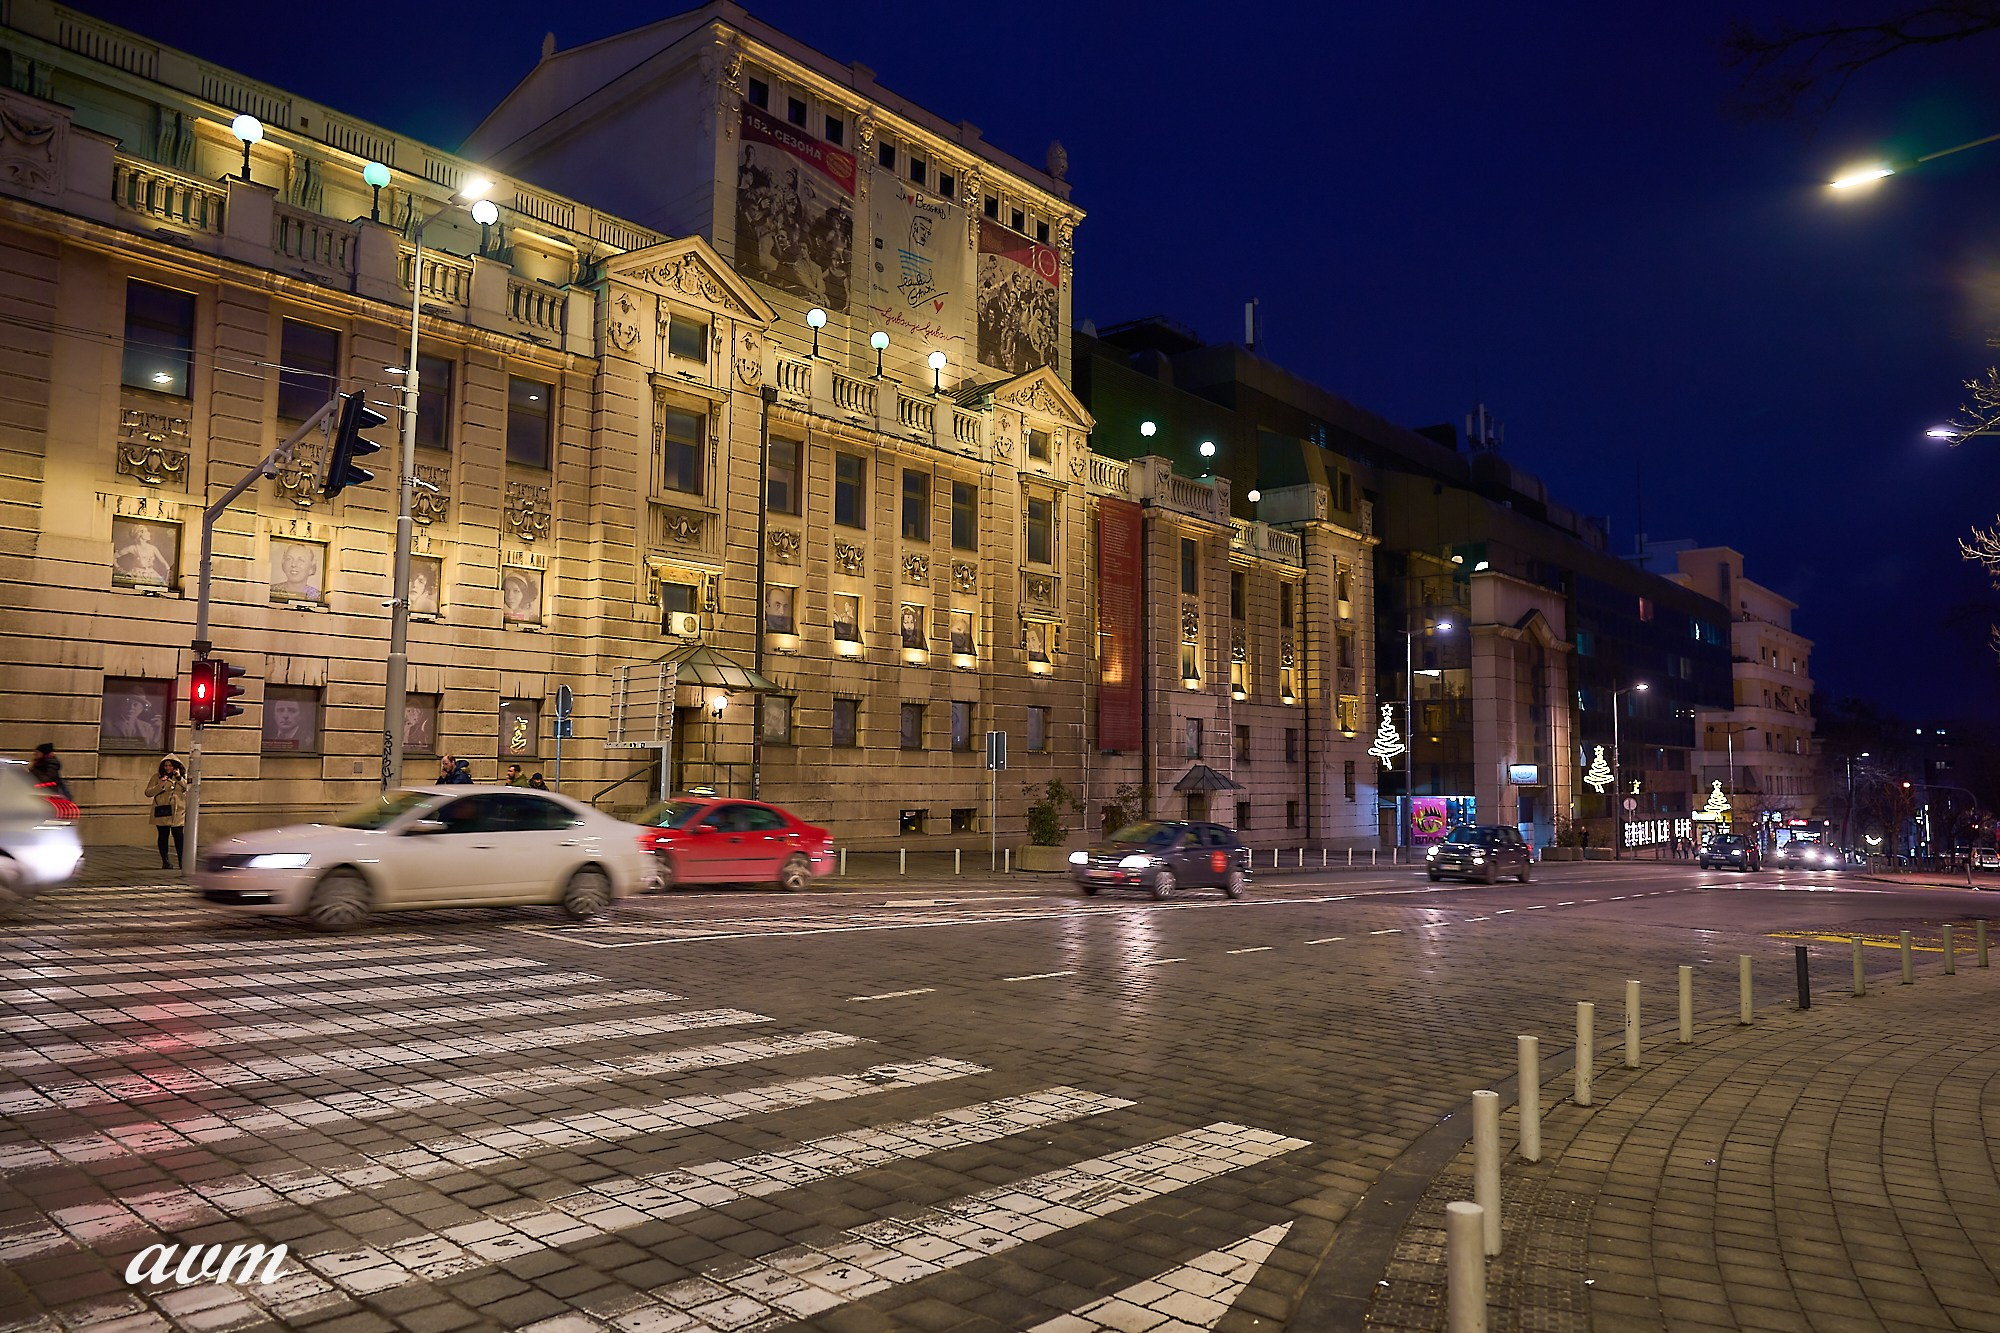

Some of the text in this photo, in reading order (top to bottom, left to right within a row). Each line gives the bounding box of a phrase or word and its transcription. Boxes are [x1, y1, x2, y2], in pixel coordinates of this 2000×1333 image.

[747, 115, 822, 161] 152. СЕЗОНА
[1028, 245, 1057, 277] 10
